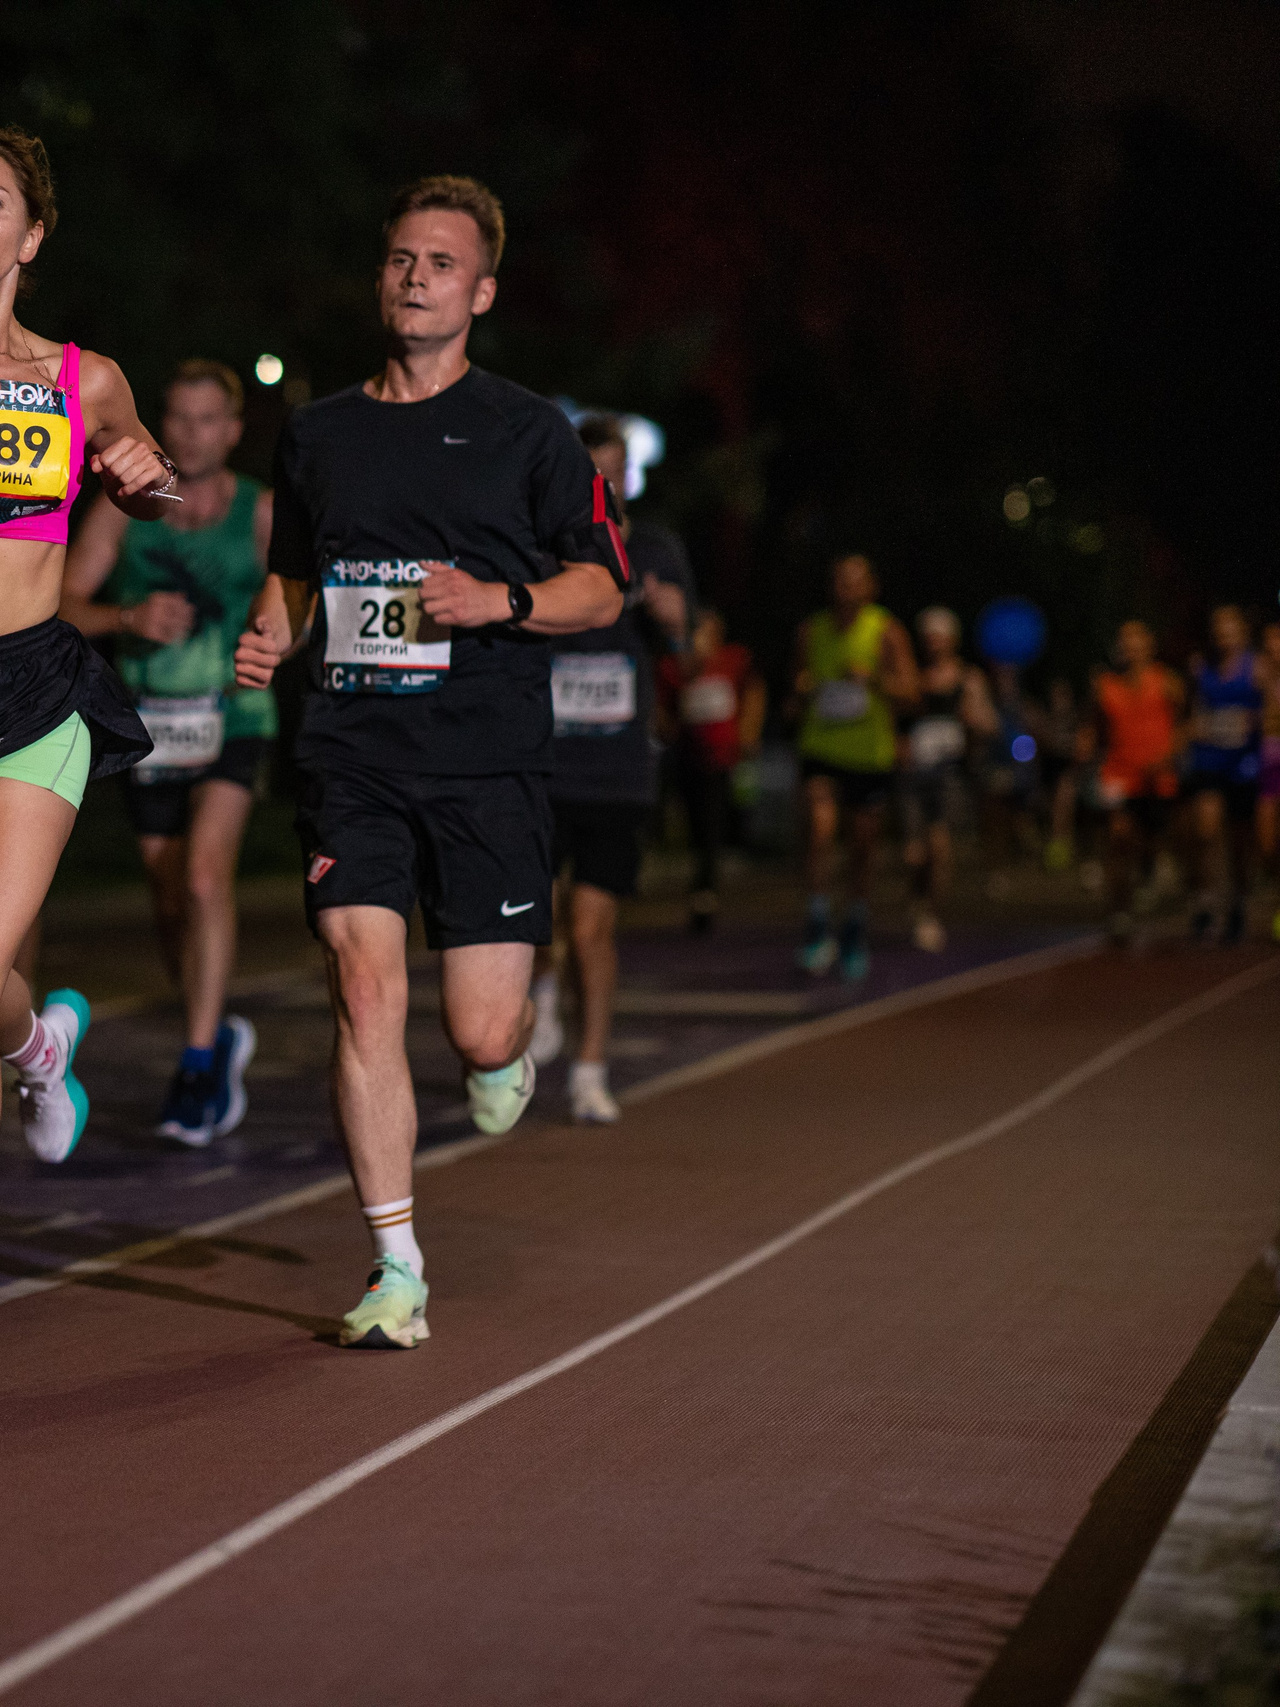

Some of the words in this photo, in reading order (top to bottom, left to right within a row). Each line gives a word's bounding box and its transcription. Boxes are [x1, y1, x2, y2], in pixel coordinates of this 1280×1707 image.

[332, 558, 425, 582] НОЧНО
[359, 599, 406, 639] 28
[353, 642, 409, 656] ГЕОРГИЙ
